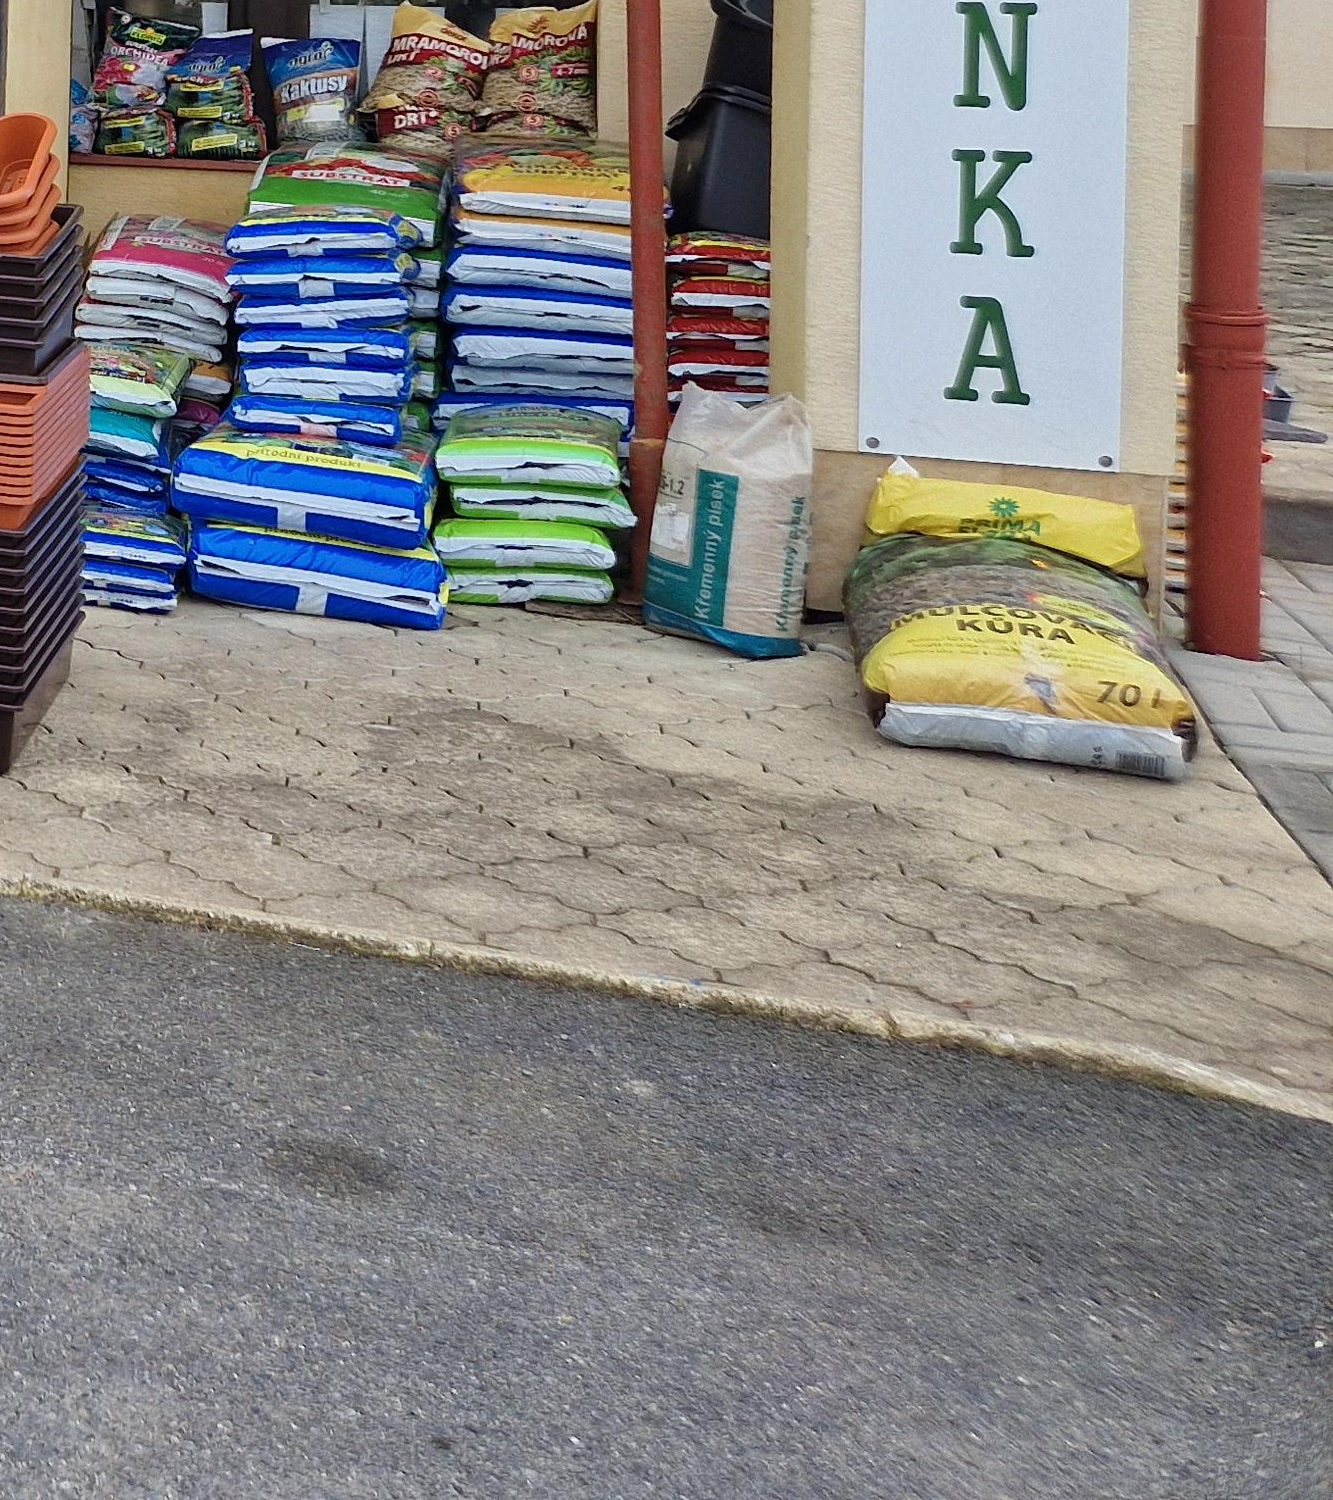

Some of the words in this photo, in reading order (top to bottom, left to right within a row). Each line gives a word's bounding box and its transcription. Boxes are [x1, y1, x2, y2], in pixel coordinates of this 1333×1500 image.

[110, 46, 169, 66] ORCHIDEA
[282, 74, 348, 104] Kaktusy
[956, 617, 1075, 645] KŮRA
[1096, 680, 1141, 708] 70
